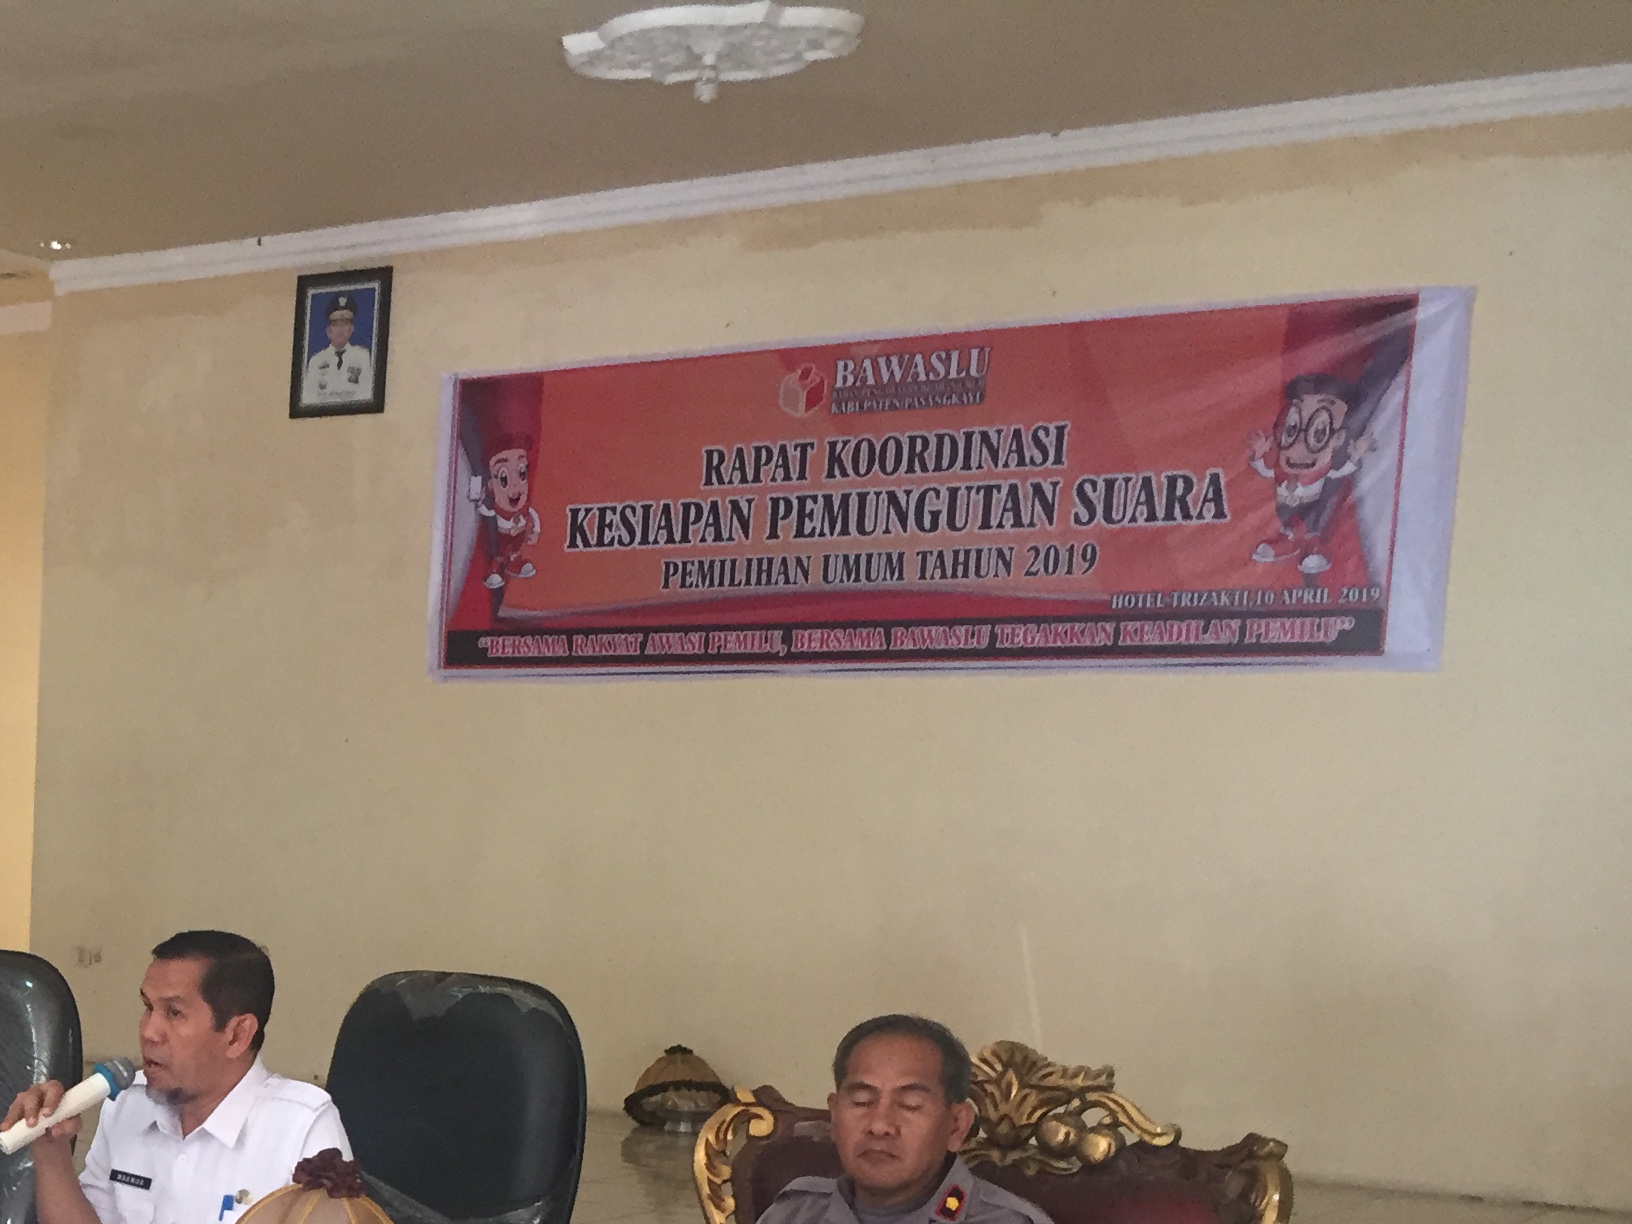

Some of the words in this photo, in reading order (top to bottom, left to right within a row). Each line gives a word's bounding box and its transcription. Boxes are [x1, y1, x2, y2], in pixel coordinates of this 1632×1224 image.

[834, 347, 991, 389] BAWASLU
[702, 440, 815, 487] RAPAT
[824, 423, 1069, 480] KOORDINASI
[565, 497, 757, 550] KESIAPAN
[765, 480, 1061, 541] PEMUNGUTAN
[1072, 471, 1228, 527] SUARA
[661, 554, 812, 590] PEMILIHAN
[821, 550, 906, 585] UMUM
[916, 545, 1015, 581] TAHUN
[1023, 542, 1099, 578] 2019
[1111, 591, 1165, 609] HOTEL
[1280, 587, 1332, 605] APRIL
[1338, 585, 1381, 604] 2019
[572, 633, 643, 655] RAKYAT
[645, 632, 706, 654] AWASI
[708, 629, 787, 657] PEMILU,
[791, 627, 886, 651] BERSAMA
[889, 624, 991, 650] BAWASLU
[994, 621, 1116, 648] TEGAKKAN
[1118, 618, 1241, 645] KEADILAN
